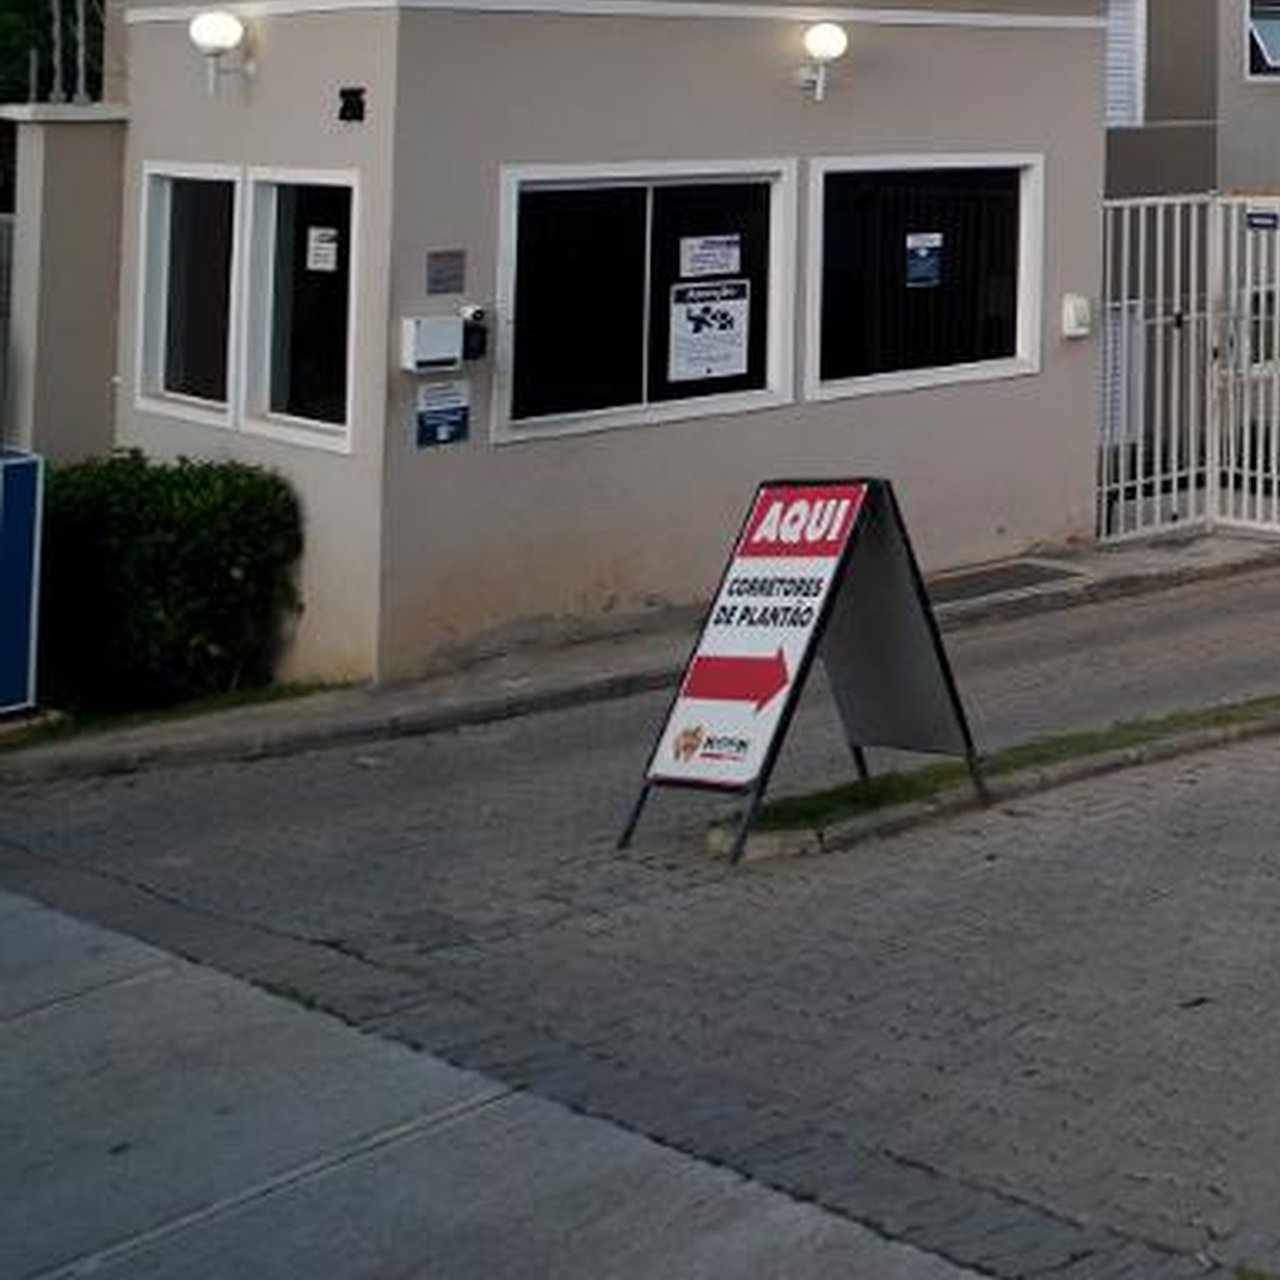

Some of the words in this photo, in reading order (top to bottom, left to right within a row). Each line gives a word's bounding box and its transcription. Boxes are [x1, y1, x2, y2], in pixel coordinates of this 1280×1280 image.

[752, 499, 850, 544] AQUI
[727, 577, 825, 598] CORRETORES
[713, 605, 738, 625] DE
[736, 598, 816, 627] PLANTÃO
